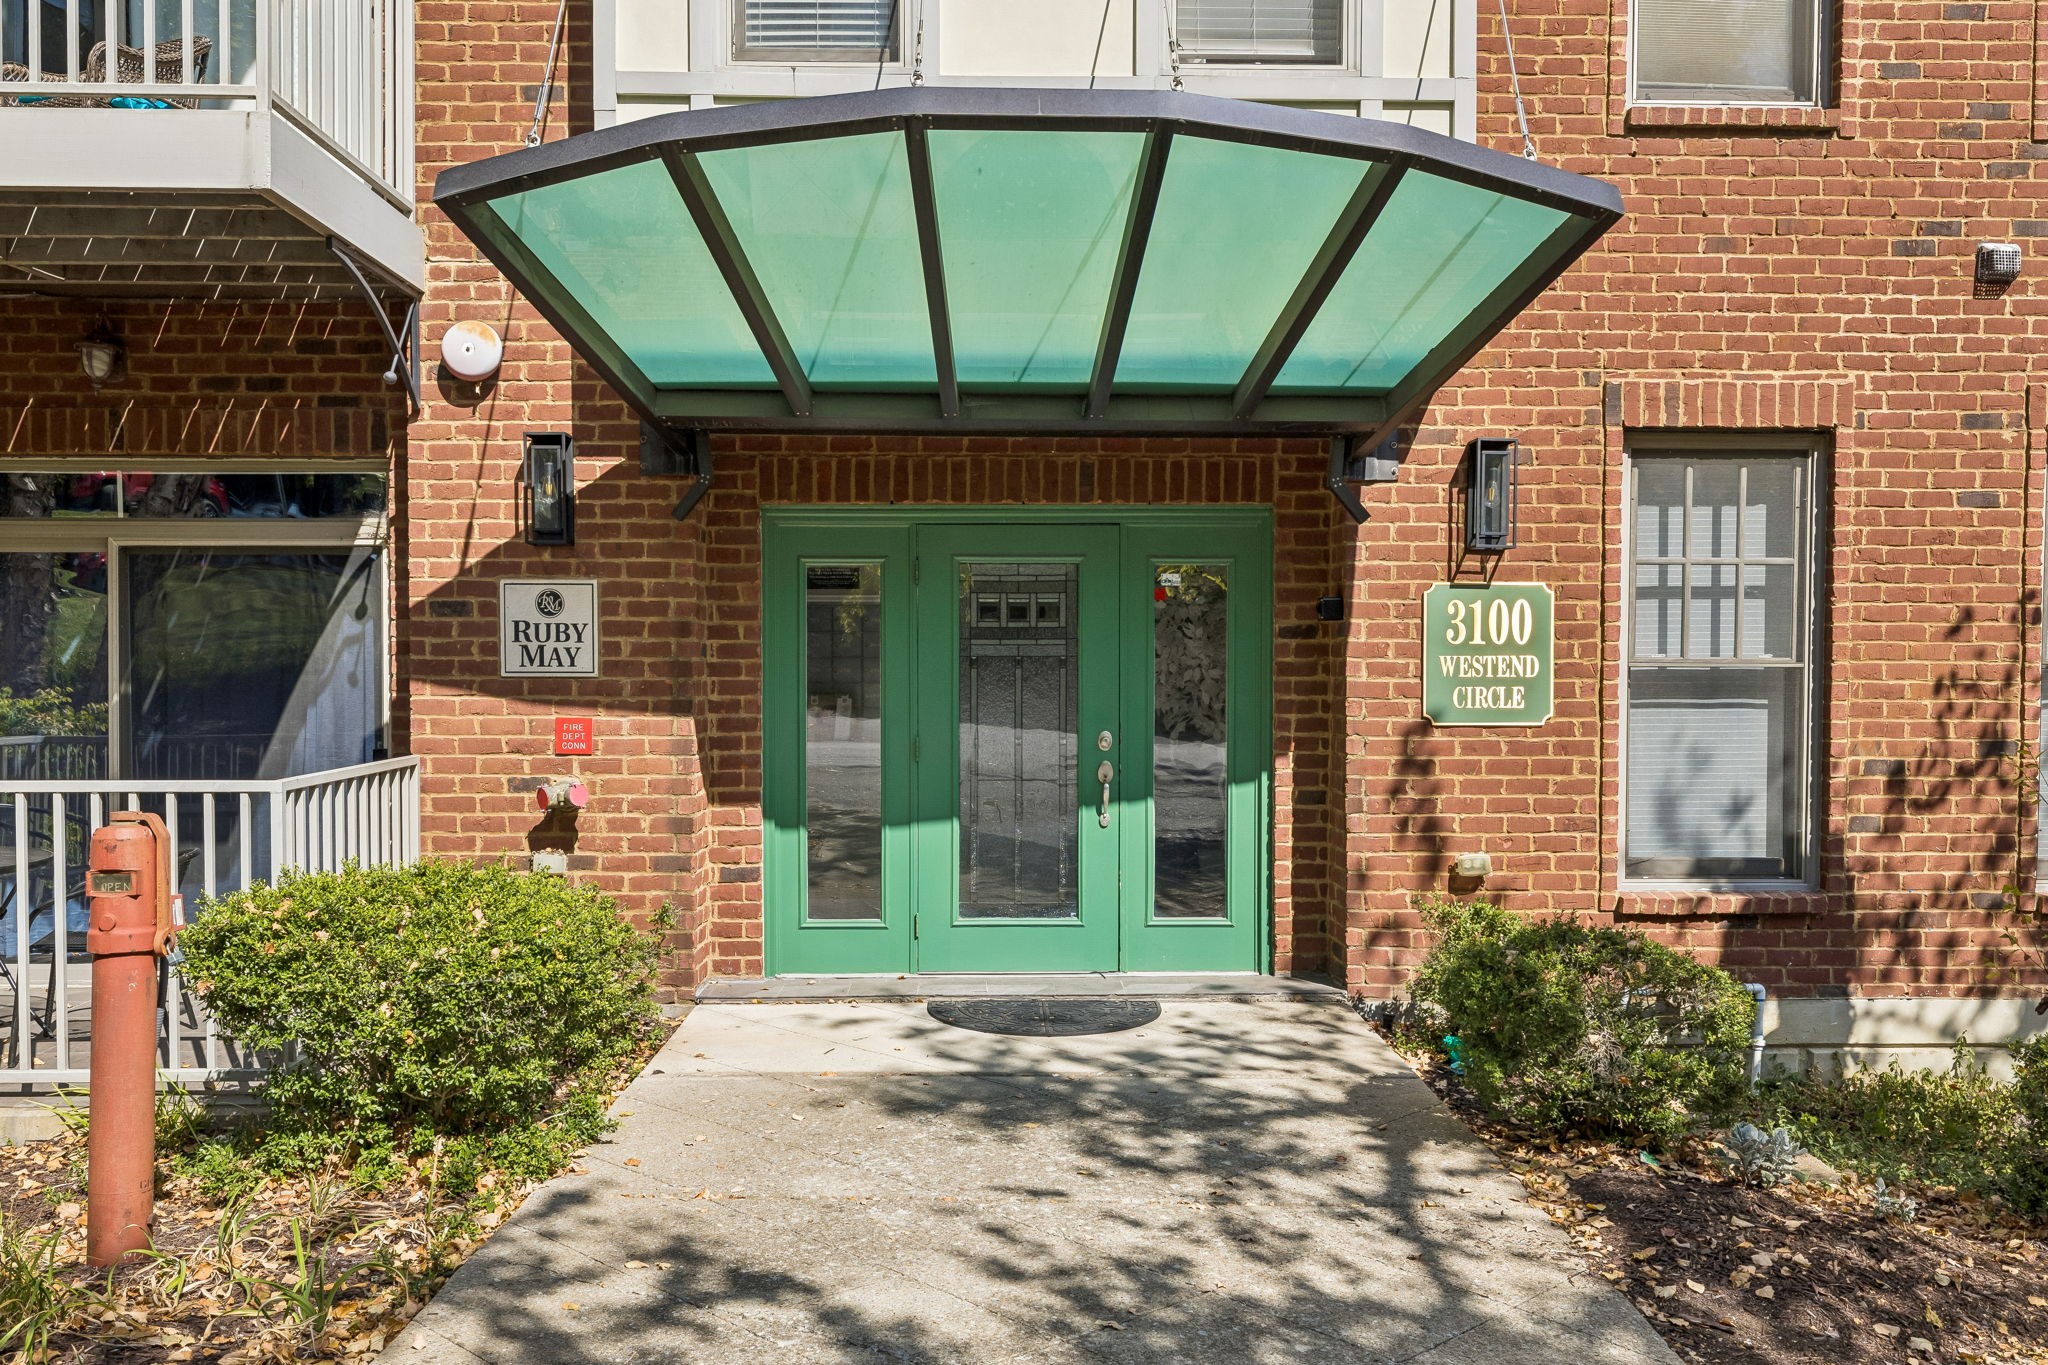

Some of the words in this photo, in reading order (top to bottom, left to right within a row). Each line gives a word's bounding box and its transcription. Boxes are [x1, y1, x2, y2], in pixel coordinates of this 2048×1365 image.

[511, 620, 589, 643] RUBY
[1446, 598, 1533, 646] 3100
[518, 644, 582, 668] MAY
[1439, 655, 1540, 678] WESTEND
[1452, 686, 1525, 709] CIRCLE
[562, 732, 585, 740] DEPT
[563, 723, 585, 731] FIRE
[561, 741, 586, 750] CONN
[101, 882, 131, 892] OPEN
